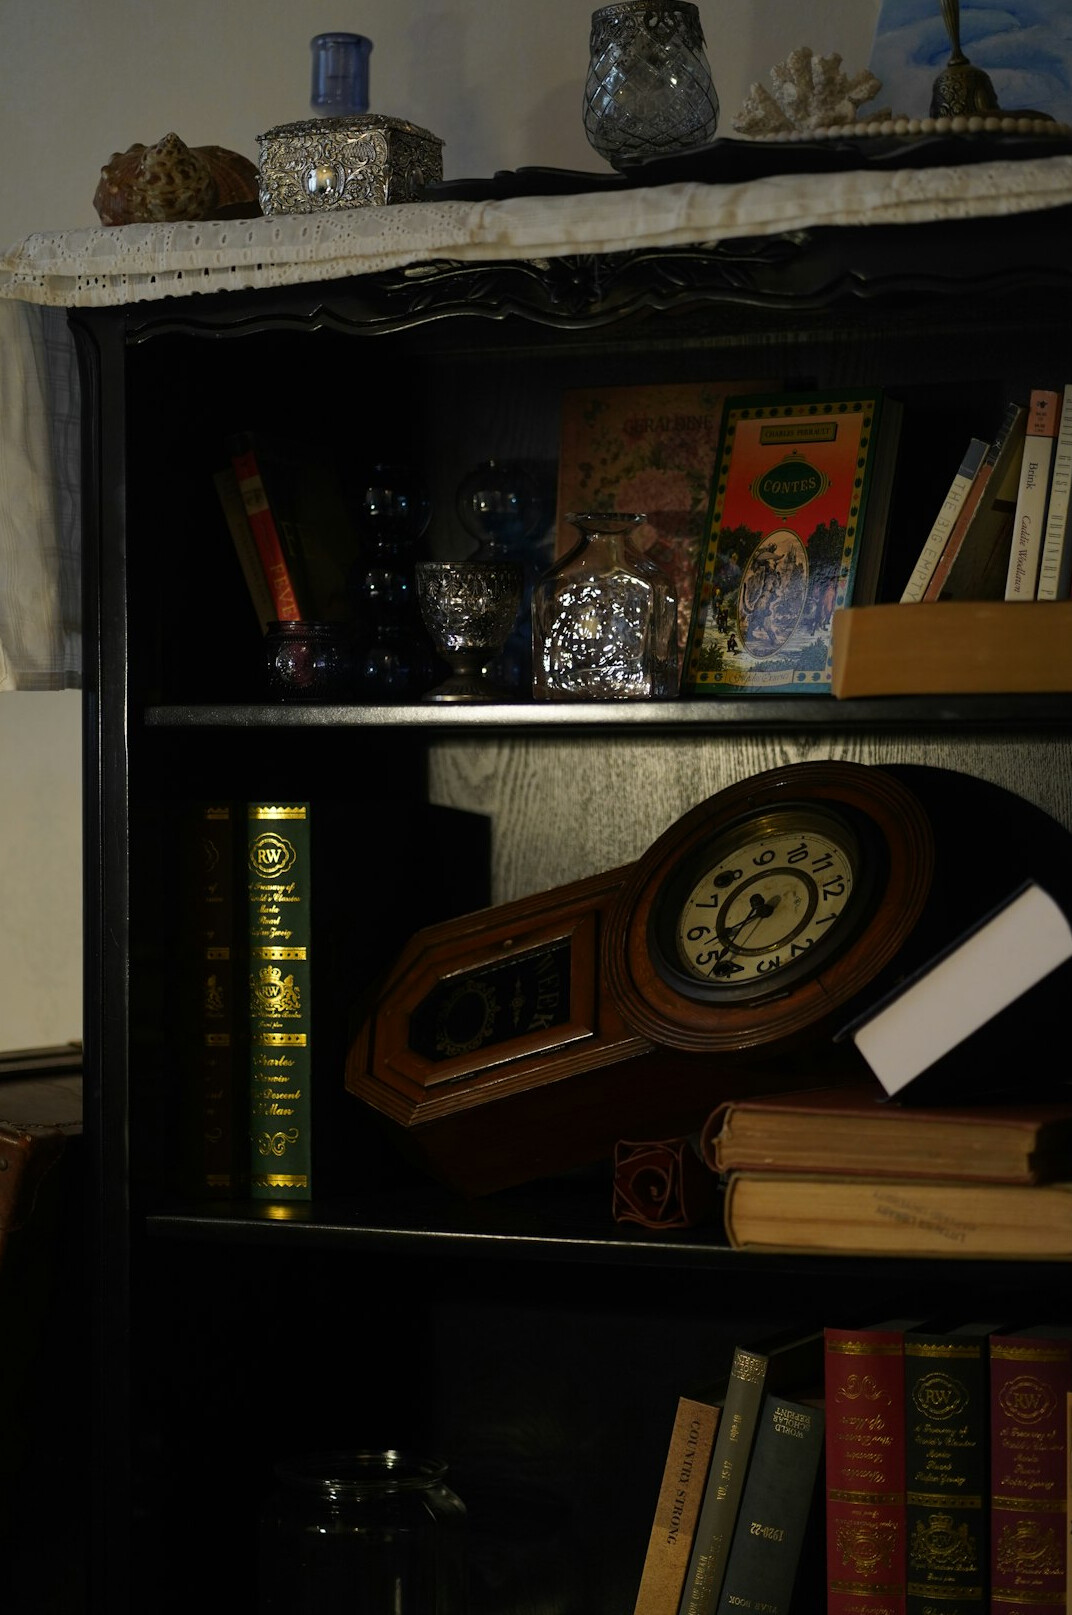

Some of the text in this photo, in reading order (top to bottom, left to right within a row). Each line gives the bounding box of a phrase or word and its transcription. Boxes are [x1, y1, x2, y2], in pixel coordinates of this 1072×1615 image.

[763, 477, 817, 493] CONTES
[1026, 462, 1038, 490] Brink
[905, 483, 966, 603] THE BIG EMPTY
[1014, 515, 1031, 593] Caddie Woodlawn
[258, 848, 283, 864] RW
[752, 850, 776, 866] 9
[787, 842, 809, 864] 10
[812, 852, 833, 874] 11
[822, 874, 845, 901] 12
[695, 894, 719, 908] 7
[815, 912, 837, 925] 1
[687, 926, 711, 942] 6
[791, 938, 814, 957] 2
[695, 950, 719, 967] 5
[756, 956, 781, 974] 3
[926, 1389, 952, 1405] RW
[772, 1415, 811, 1432] SCHOLAR
[773, 1406, 812, 1425] REPRINT
[666, 1419, 700, 1547] COUNTRY STRONG
[749, 1521, 786, 1543] 1920-22
[728, 1594, 750, 1607] BOOK
